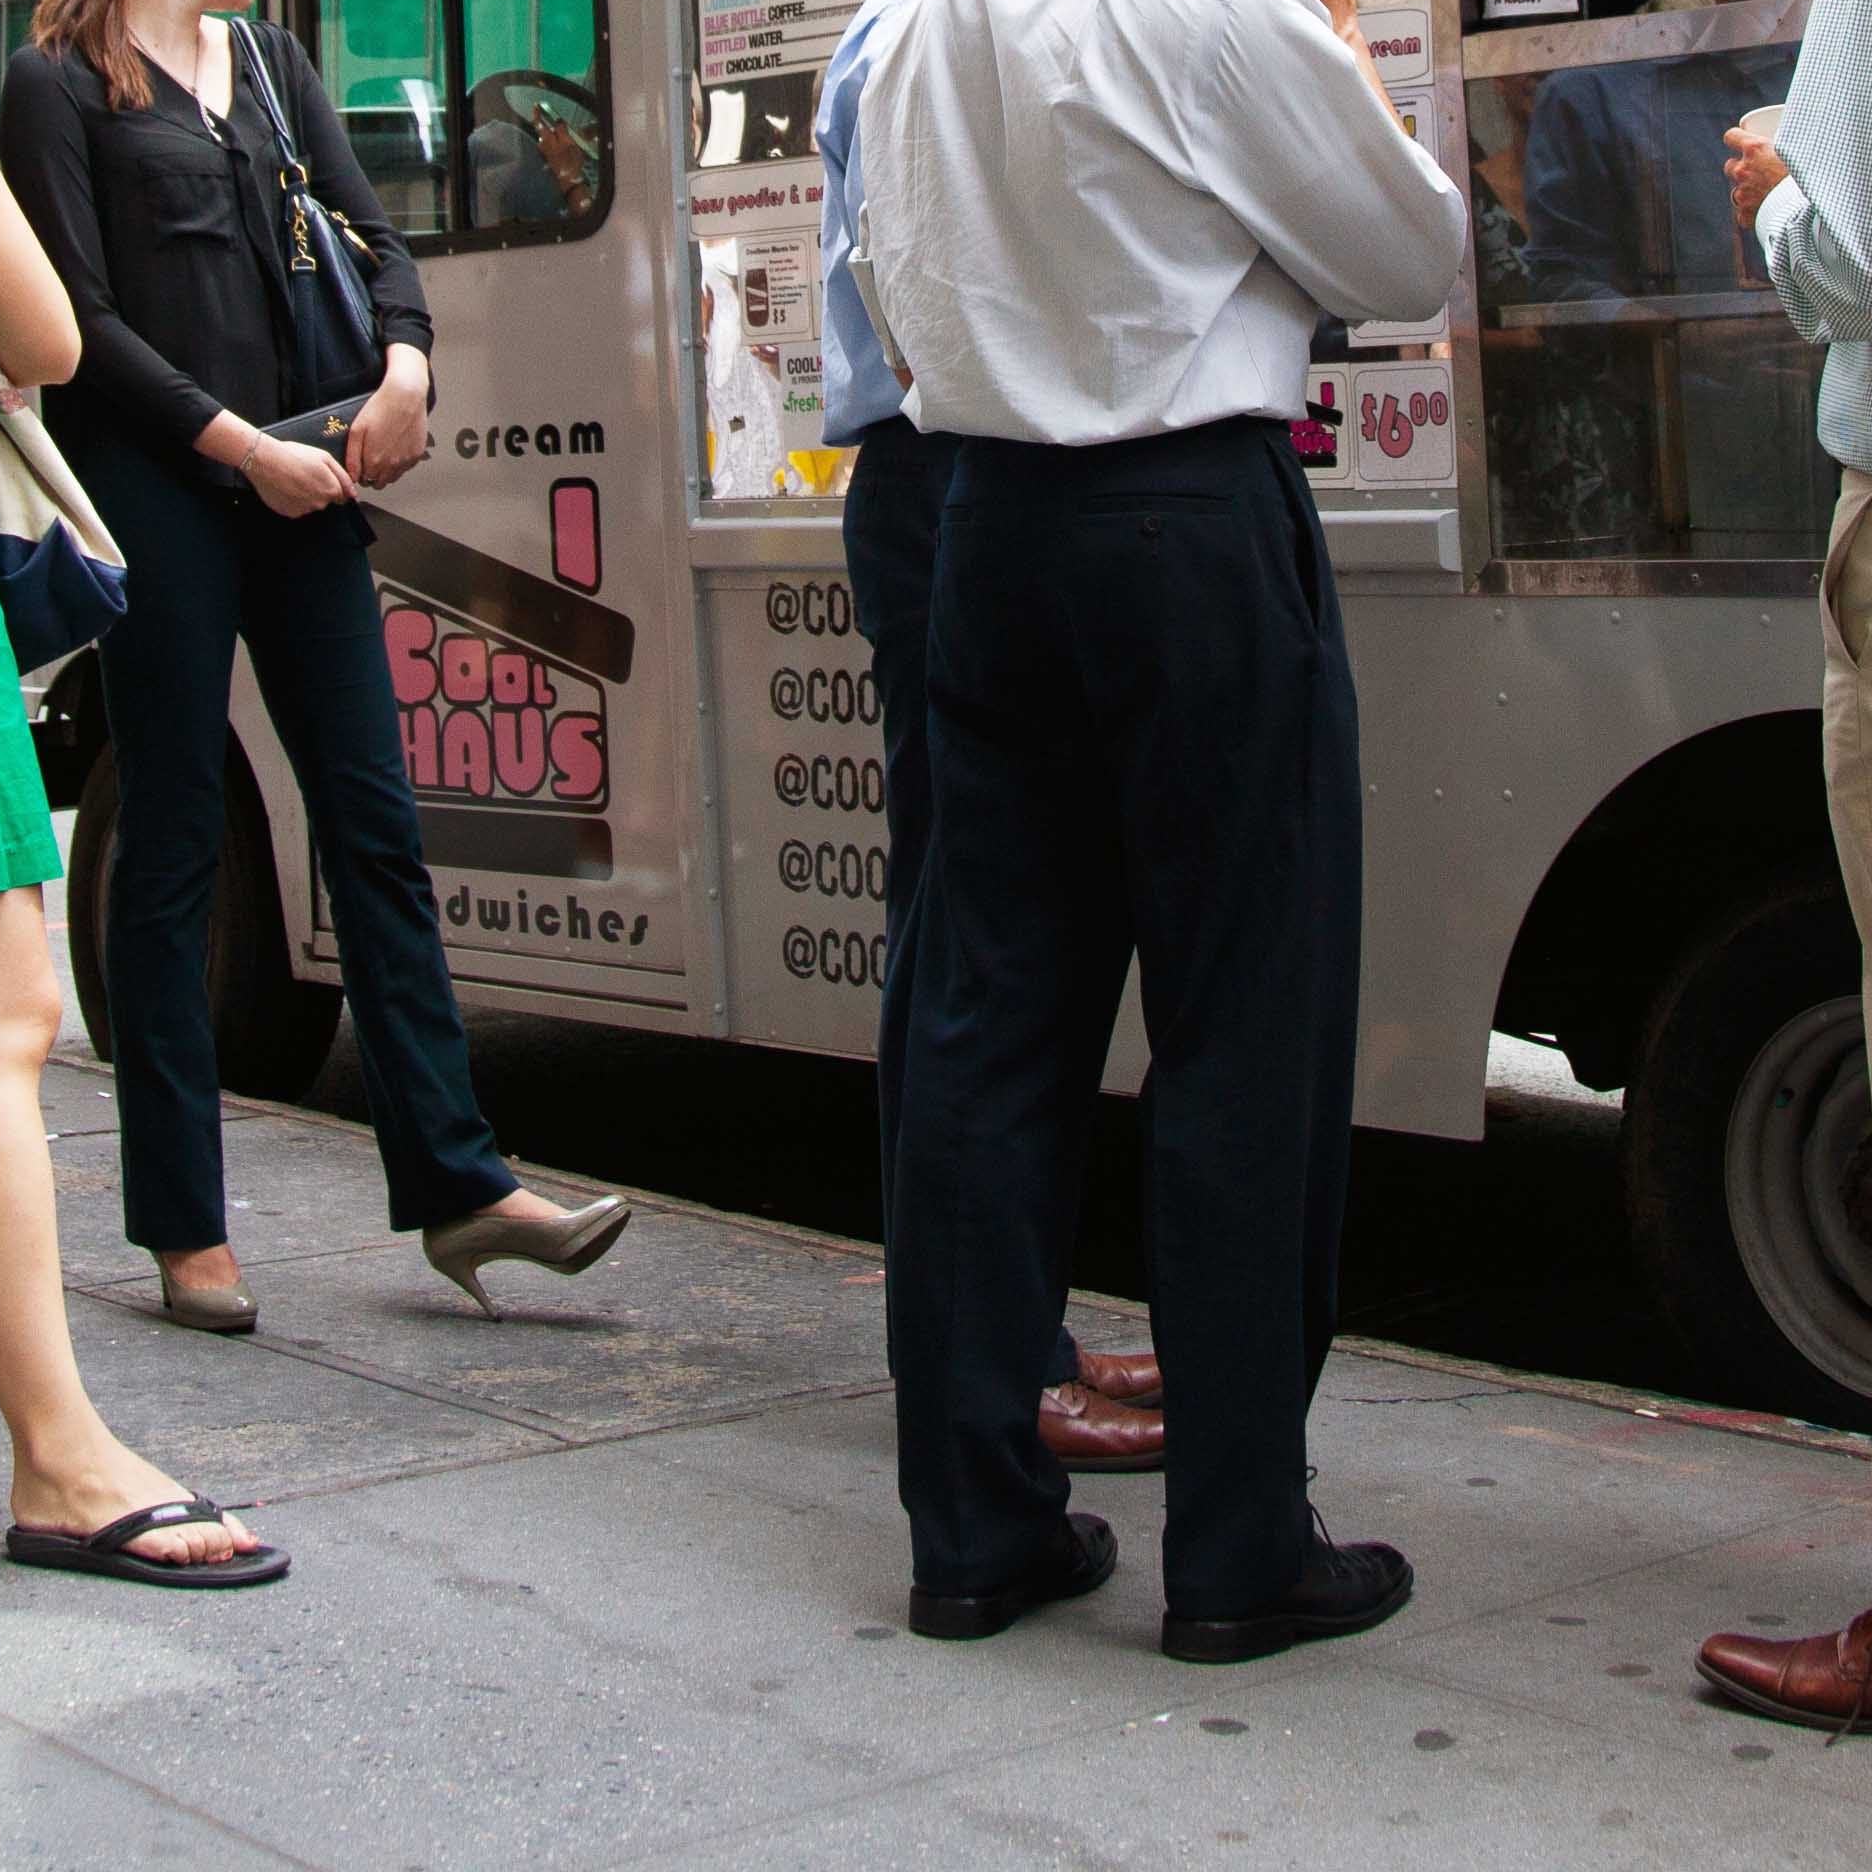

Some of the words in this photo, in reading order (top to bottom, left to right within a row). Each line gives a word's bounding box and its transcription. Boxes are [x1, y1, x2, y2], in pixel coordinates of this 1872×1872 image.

[704, 12, 729, 32] BLUE
[731, 7, 766, 27] BOTTLE
[768, 1, 806, 21] COFFEE
[705, 35, 746, 56] BOTTLED
[748, 30, 783, 48] WATER
[1369, 36, 1421, 58] ream
[706, 61, 724, 78] HOT
[725, 52, 782, 74] CHOCOLATE
[691, 196, 724, 215] haus
[727, 187, 785, 216] goodies
[454, 420, 606, 459] cream
[382, 603, 557, 709] COOL
[397, 701, 605, 801] HAUS
